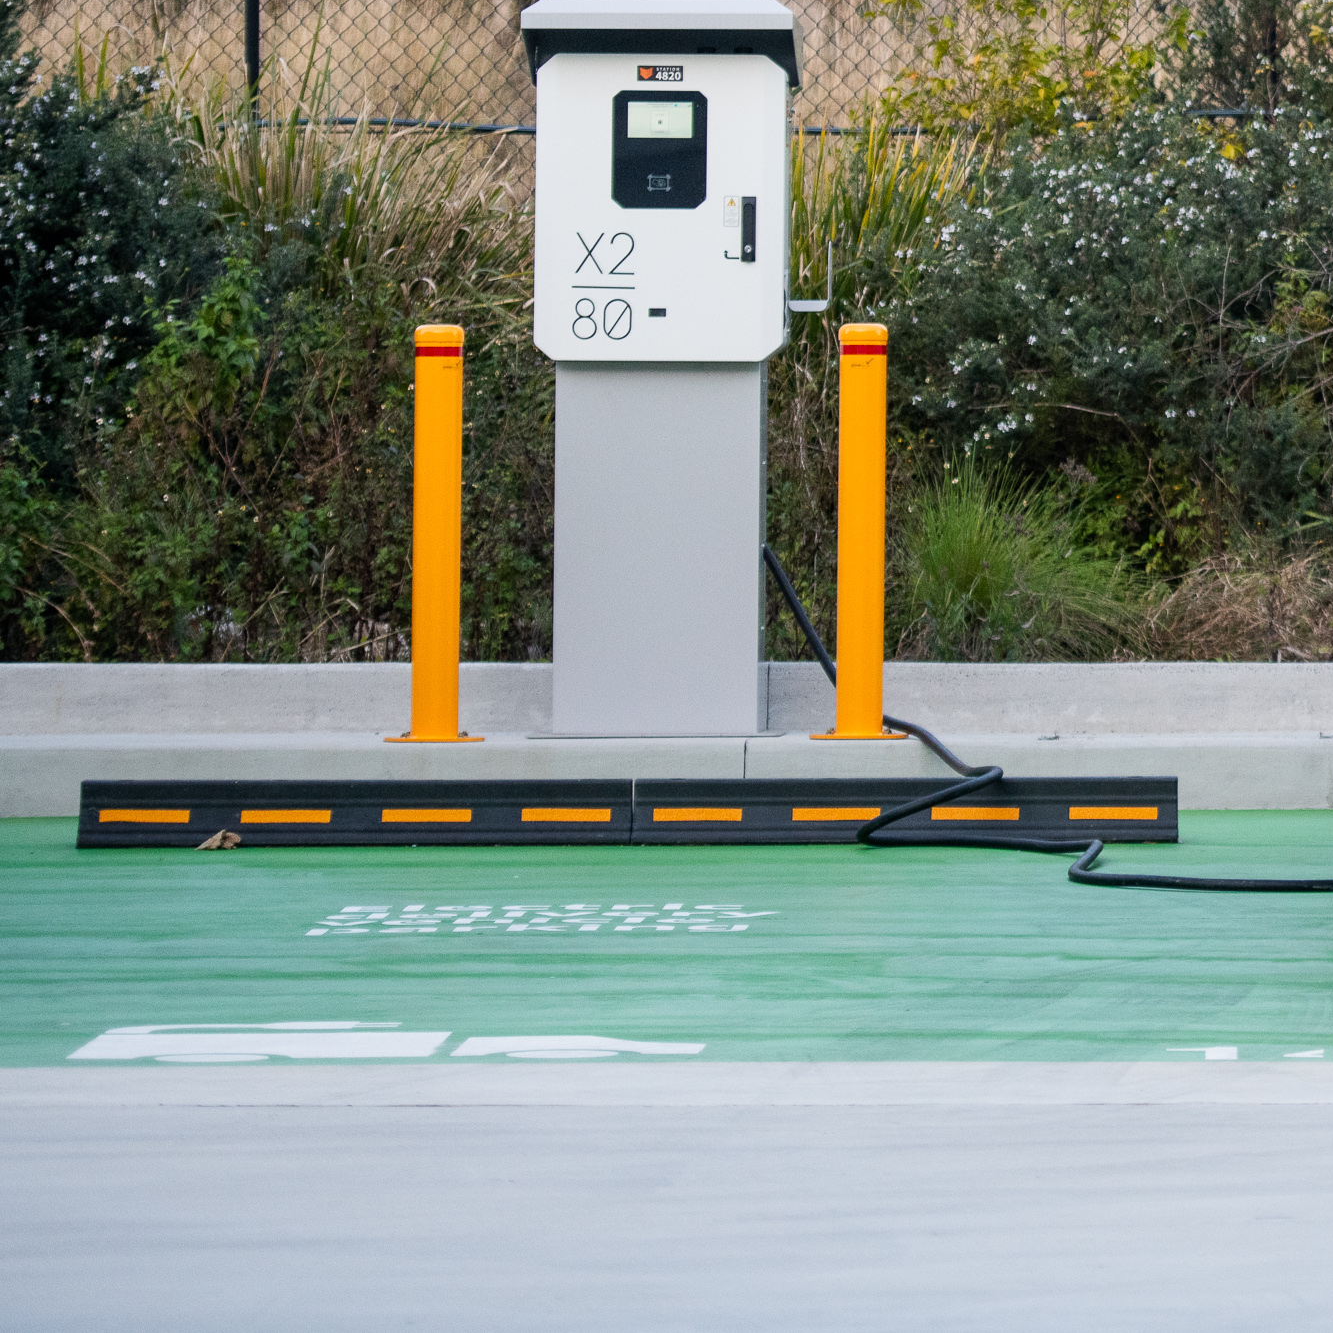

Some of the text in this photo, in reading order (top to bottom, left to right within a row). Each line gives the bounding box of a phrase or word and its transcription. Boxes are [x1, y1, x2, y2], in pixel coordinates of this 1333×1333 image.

[655, 71, 681, 81] 4820
[575, 231, 635, 275] X2
[340, 903, 745, 913] Electric
[326, 911, 781, 920] delivery
[316, 917, 716, 927] vehicle
[305, 924, 749, 936] parking
